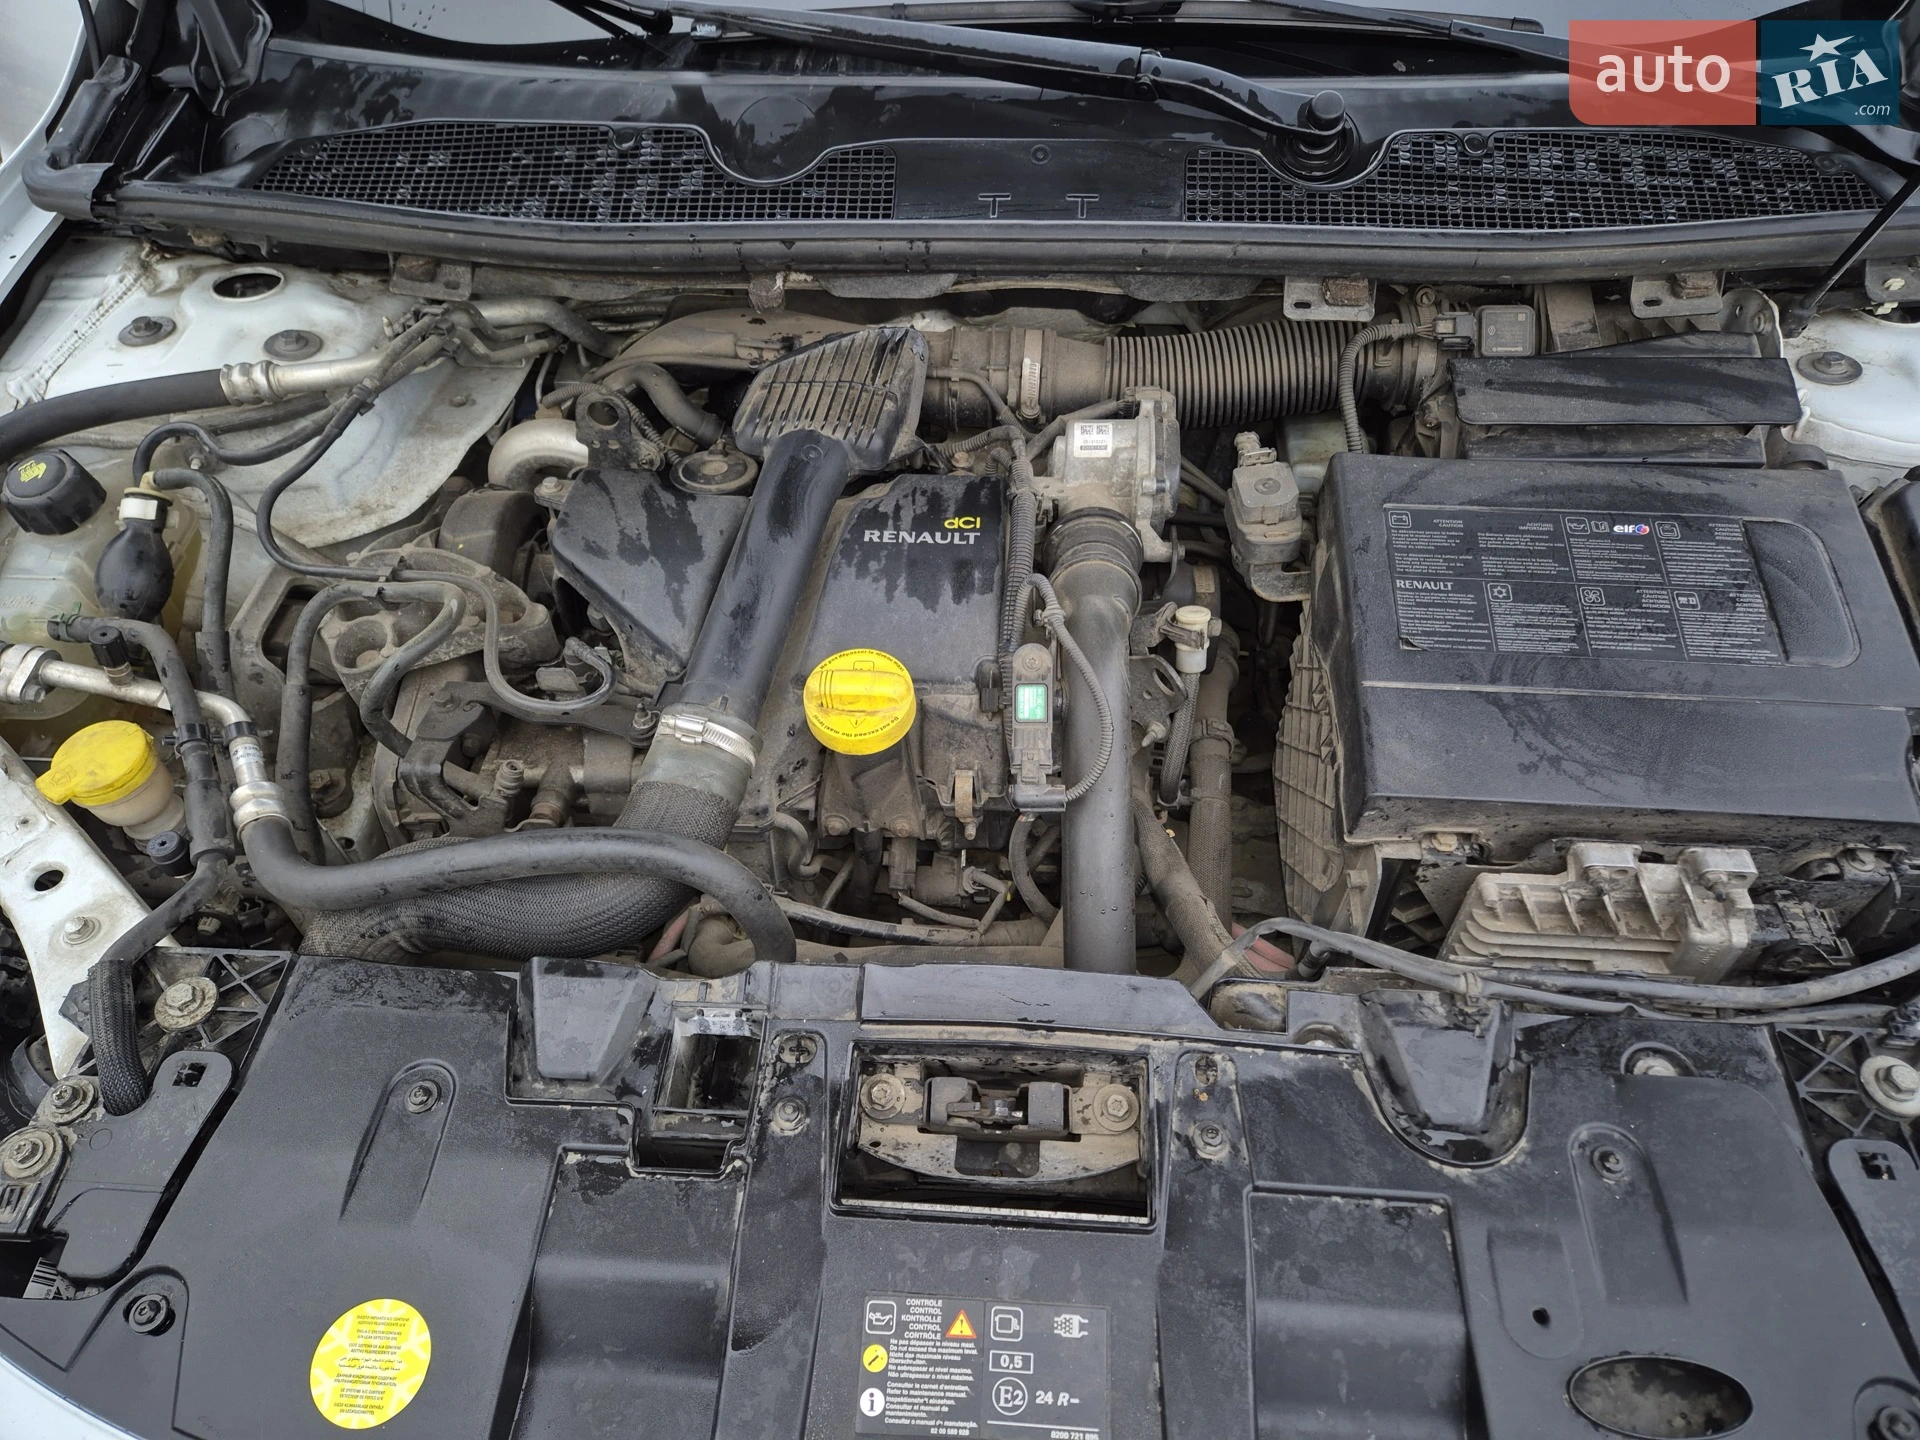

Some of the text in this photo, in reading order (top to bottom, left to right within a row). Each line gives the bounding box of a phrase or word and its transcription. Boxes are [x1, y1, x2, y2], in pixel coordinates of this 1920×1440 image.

[1613, 524, 1636, 533] elf
[864, 530, 980, 544] RENAULT
[1396, 580, 1453, 590] RENAULT
[906, 1298, 942, 1307] CONTROLE
[910, 1306, 942, 1315] CONTROL
[901, 1314, 942, 1323] KONTROLLE
[909, 1323, 941, 1331] CONTROL
[1000, 1354, 1022, 1369] 0,5
[999, 1385, 1024, 1407] E2
[1035, 1390, 1054, 1405] 24
[1051, 1430, 1069, 1439] 8200
[1070, 1431, 1083, 1440] 721
